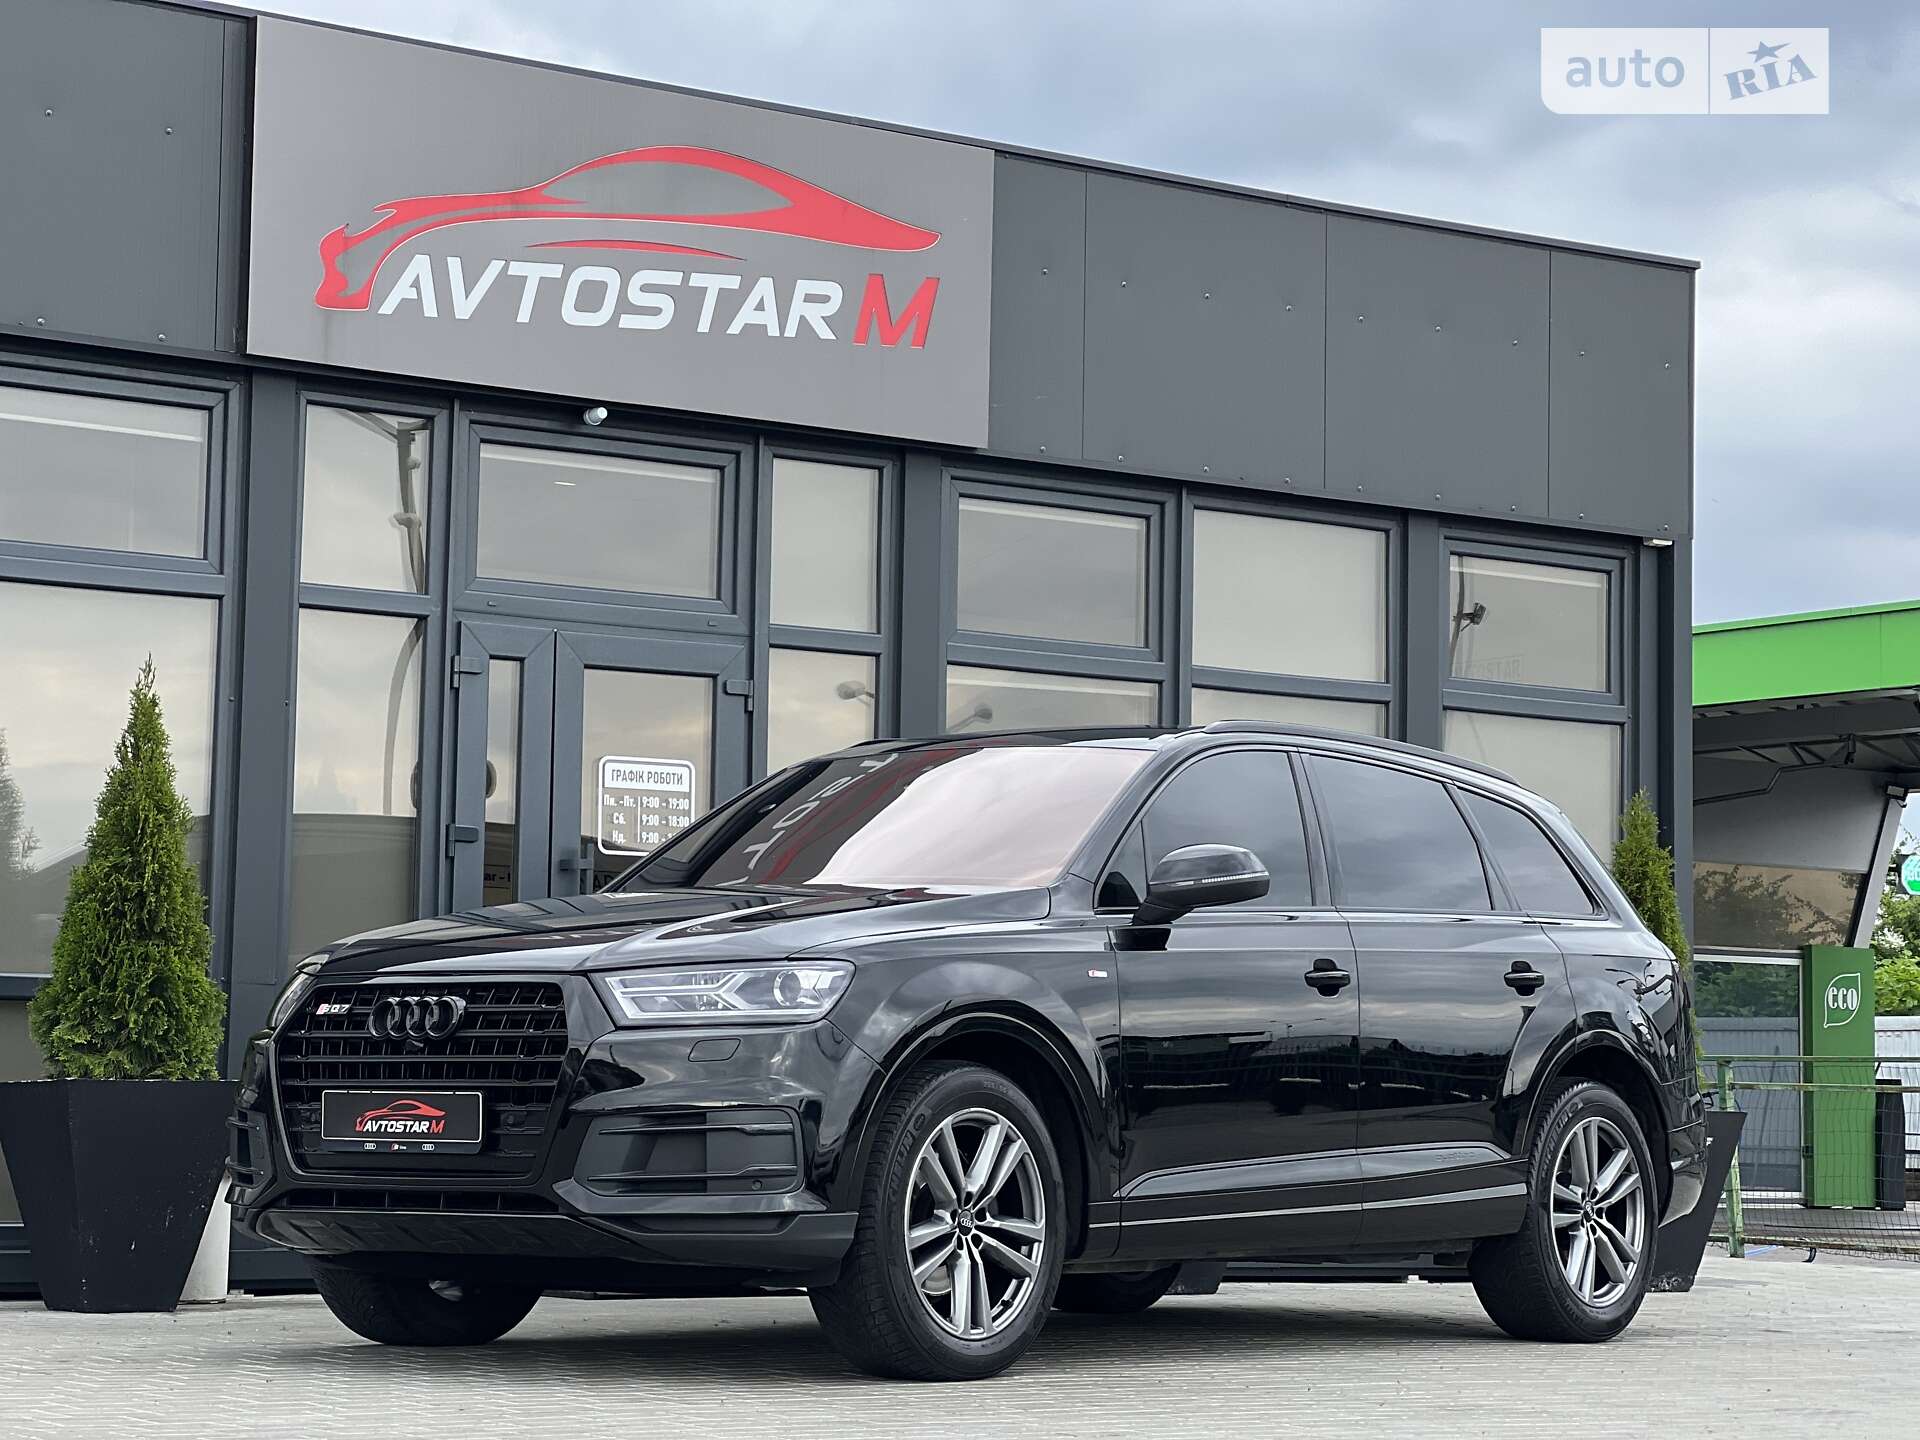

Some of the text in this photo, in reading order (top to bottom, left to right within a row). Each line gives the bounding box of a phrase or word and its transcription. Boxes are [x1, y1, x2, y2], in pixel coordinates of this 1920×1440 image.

[377, 254, 941, 350] AVTOSTAR M
[611, 769, 683, 785] ГРАФІК РОБОТИ
[642, 797, 659, 808] 9:00
[668, 798, 690, 810] 19:00
[641, 814, 659, 826] 9:00
[641, 832, 659, 844] 9:00
[1828, 986, 1858, 1011] eco
[363, 1119, 446, 1134] AVTOSTAR M
